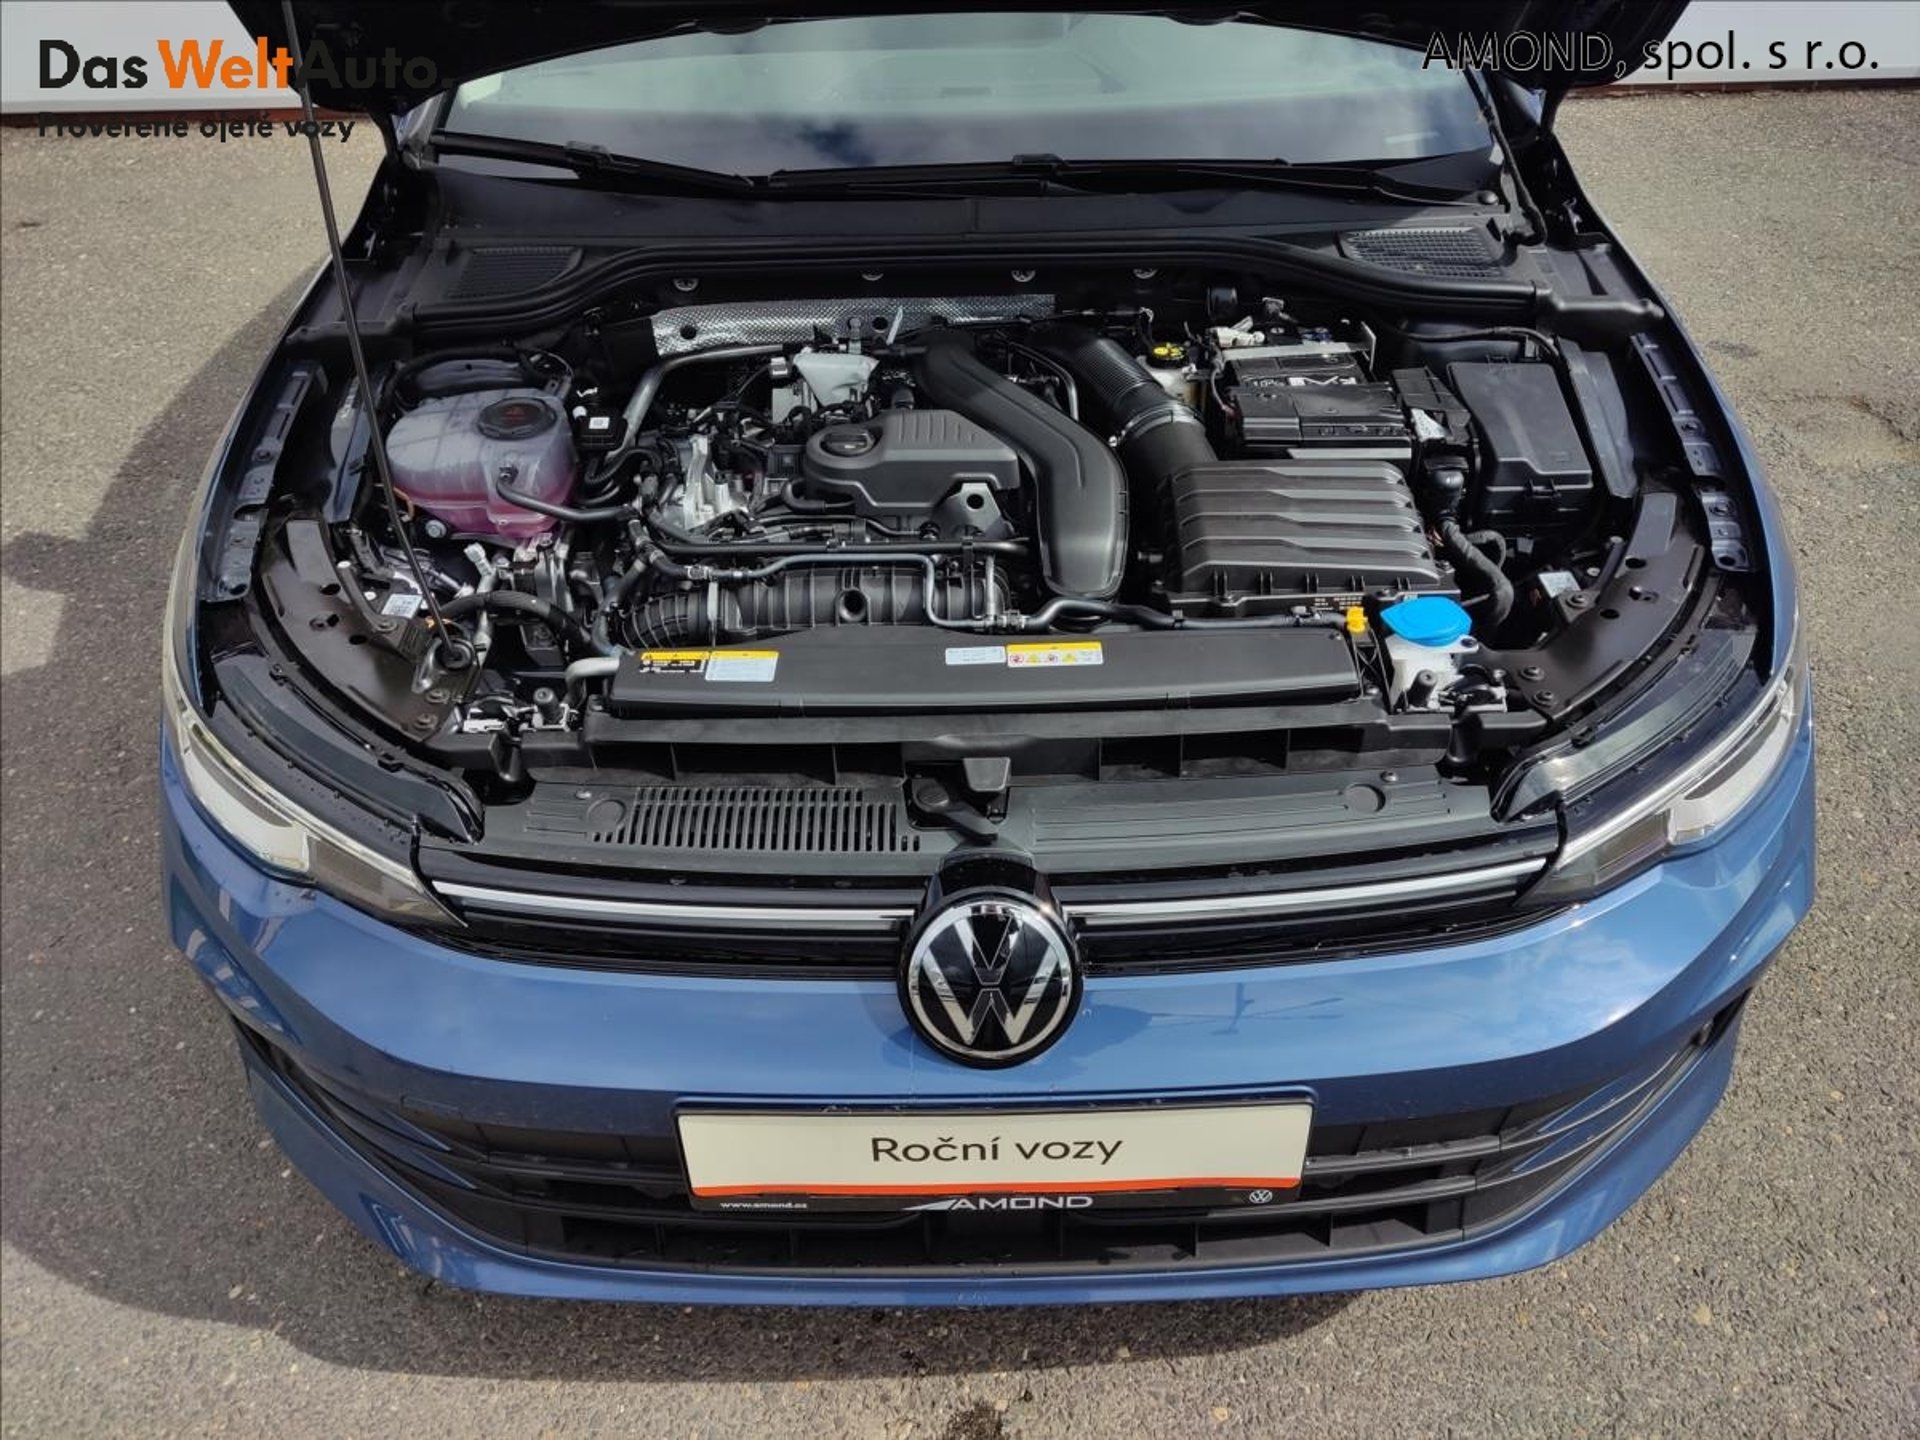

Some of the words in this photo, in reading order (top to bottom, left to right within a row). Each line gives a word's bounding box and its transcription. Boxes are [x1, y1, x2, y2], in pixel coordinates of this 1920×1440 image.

[871, 1136, 1002, 1163] Roční
[1014, 1139, 1123, 1166] vozy
[951, 1195, 1094, 1211] AMOND
